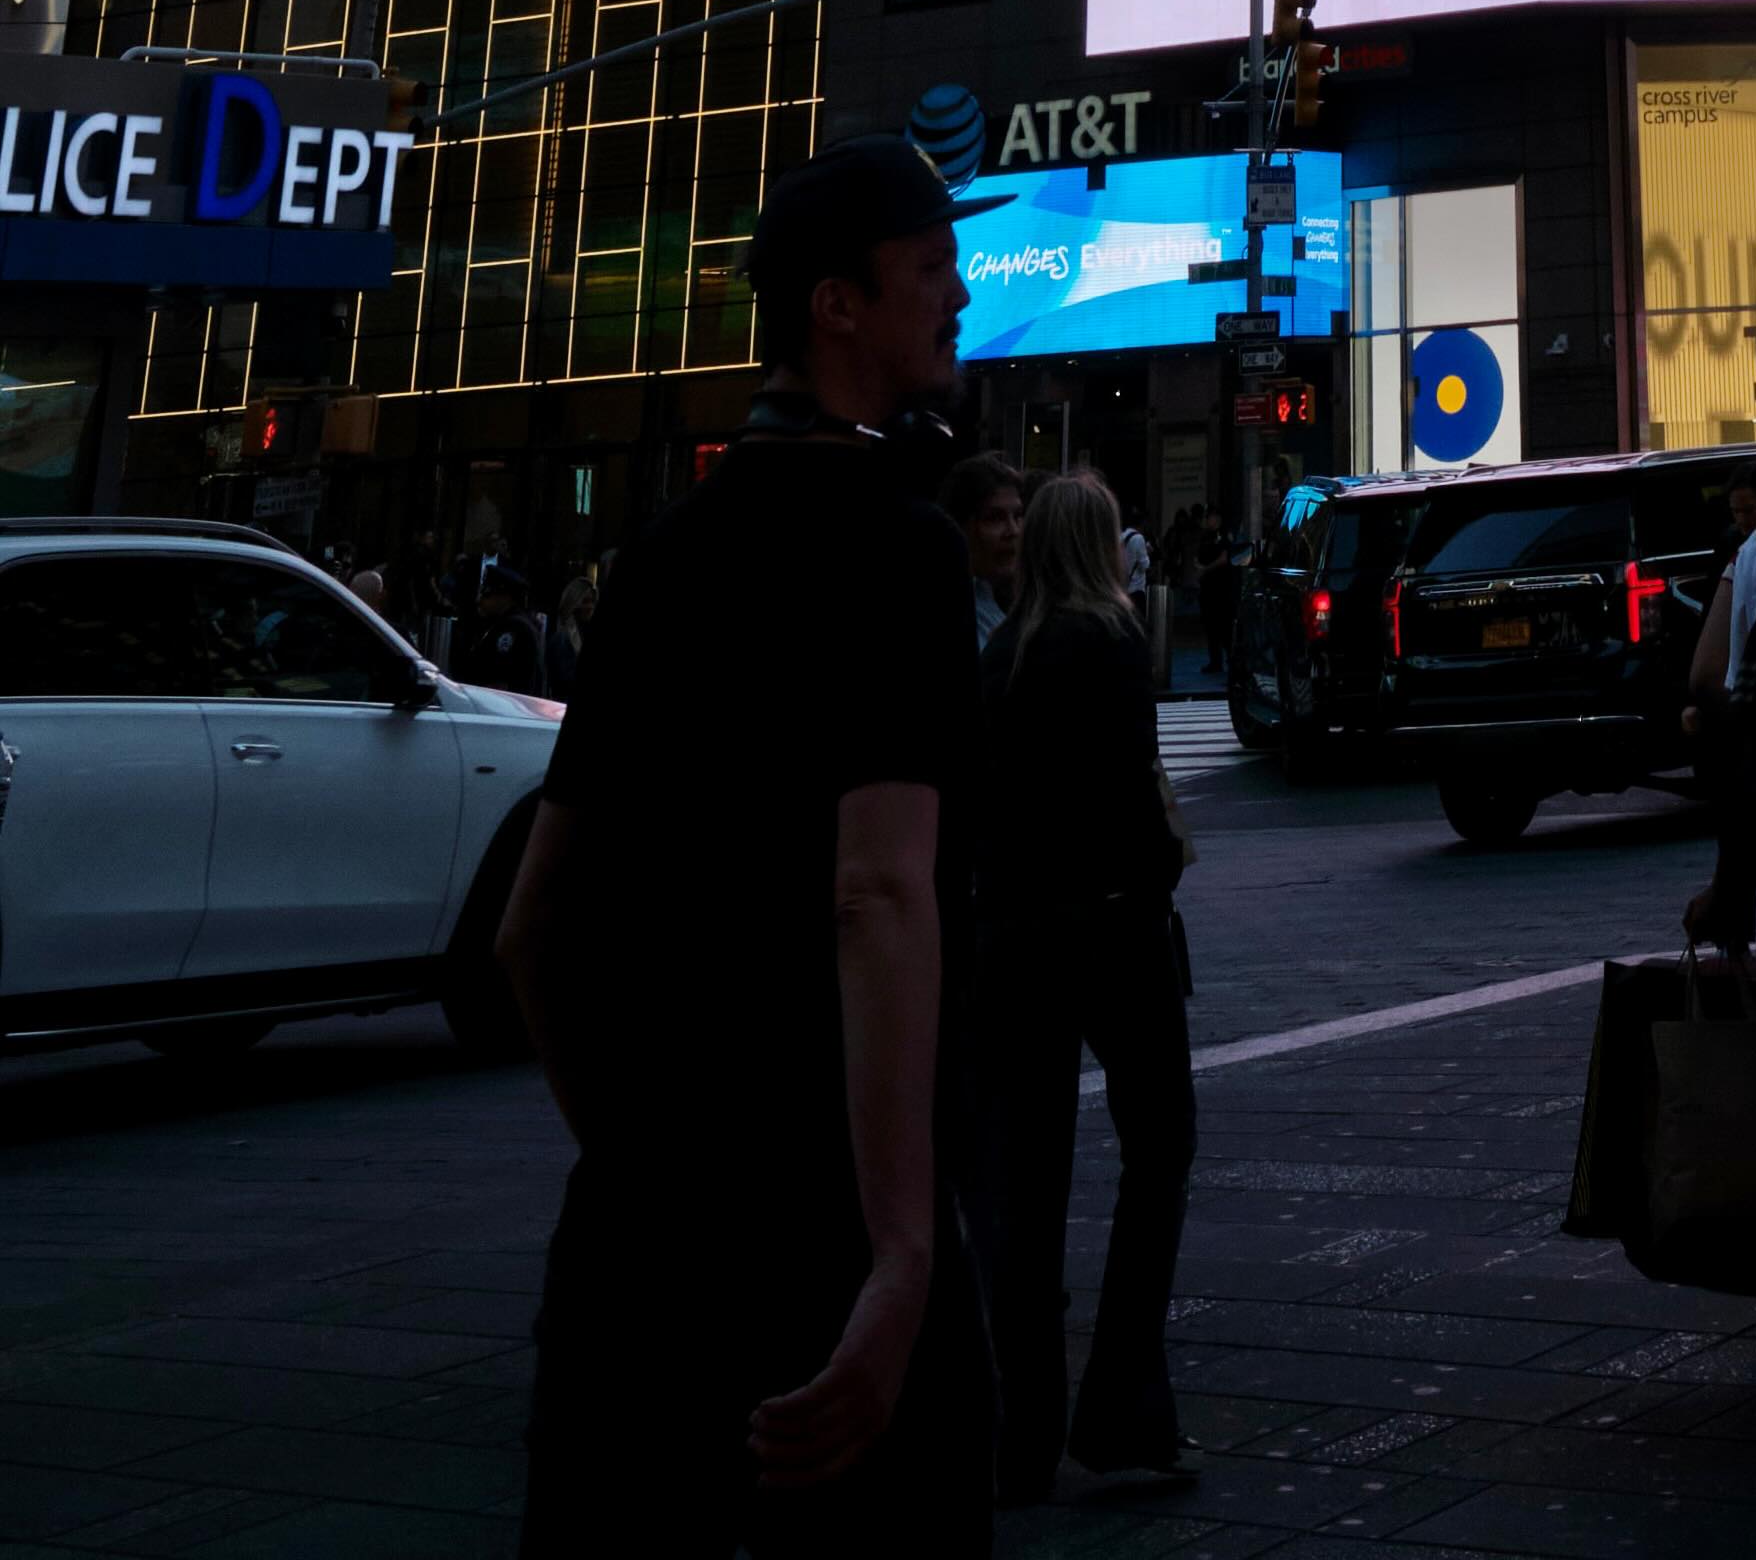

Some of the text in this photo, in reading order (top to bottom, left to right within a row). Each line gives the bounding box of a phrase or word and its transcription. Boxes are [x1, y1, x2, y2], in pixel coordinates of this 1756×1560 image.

[1642, 85, 1739, 106] cross river
[999, 90, 1152, 166] AT&T
[1643, 108, 1718, 128] campus
[195, 72, 415, 232] DEPT
[967, 243, 1069, 286] CHANGES
[1223, 319, 1273, 331] ONE WAY
